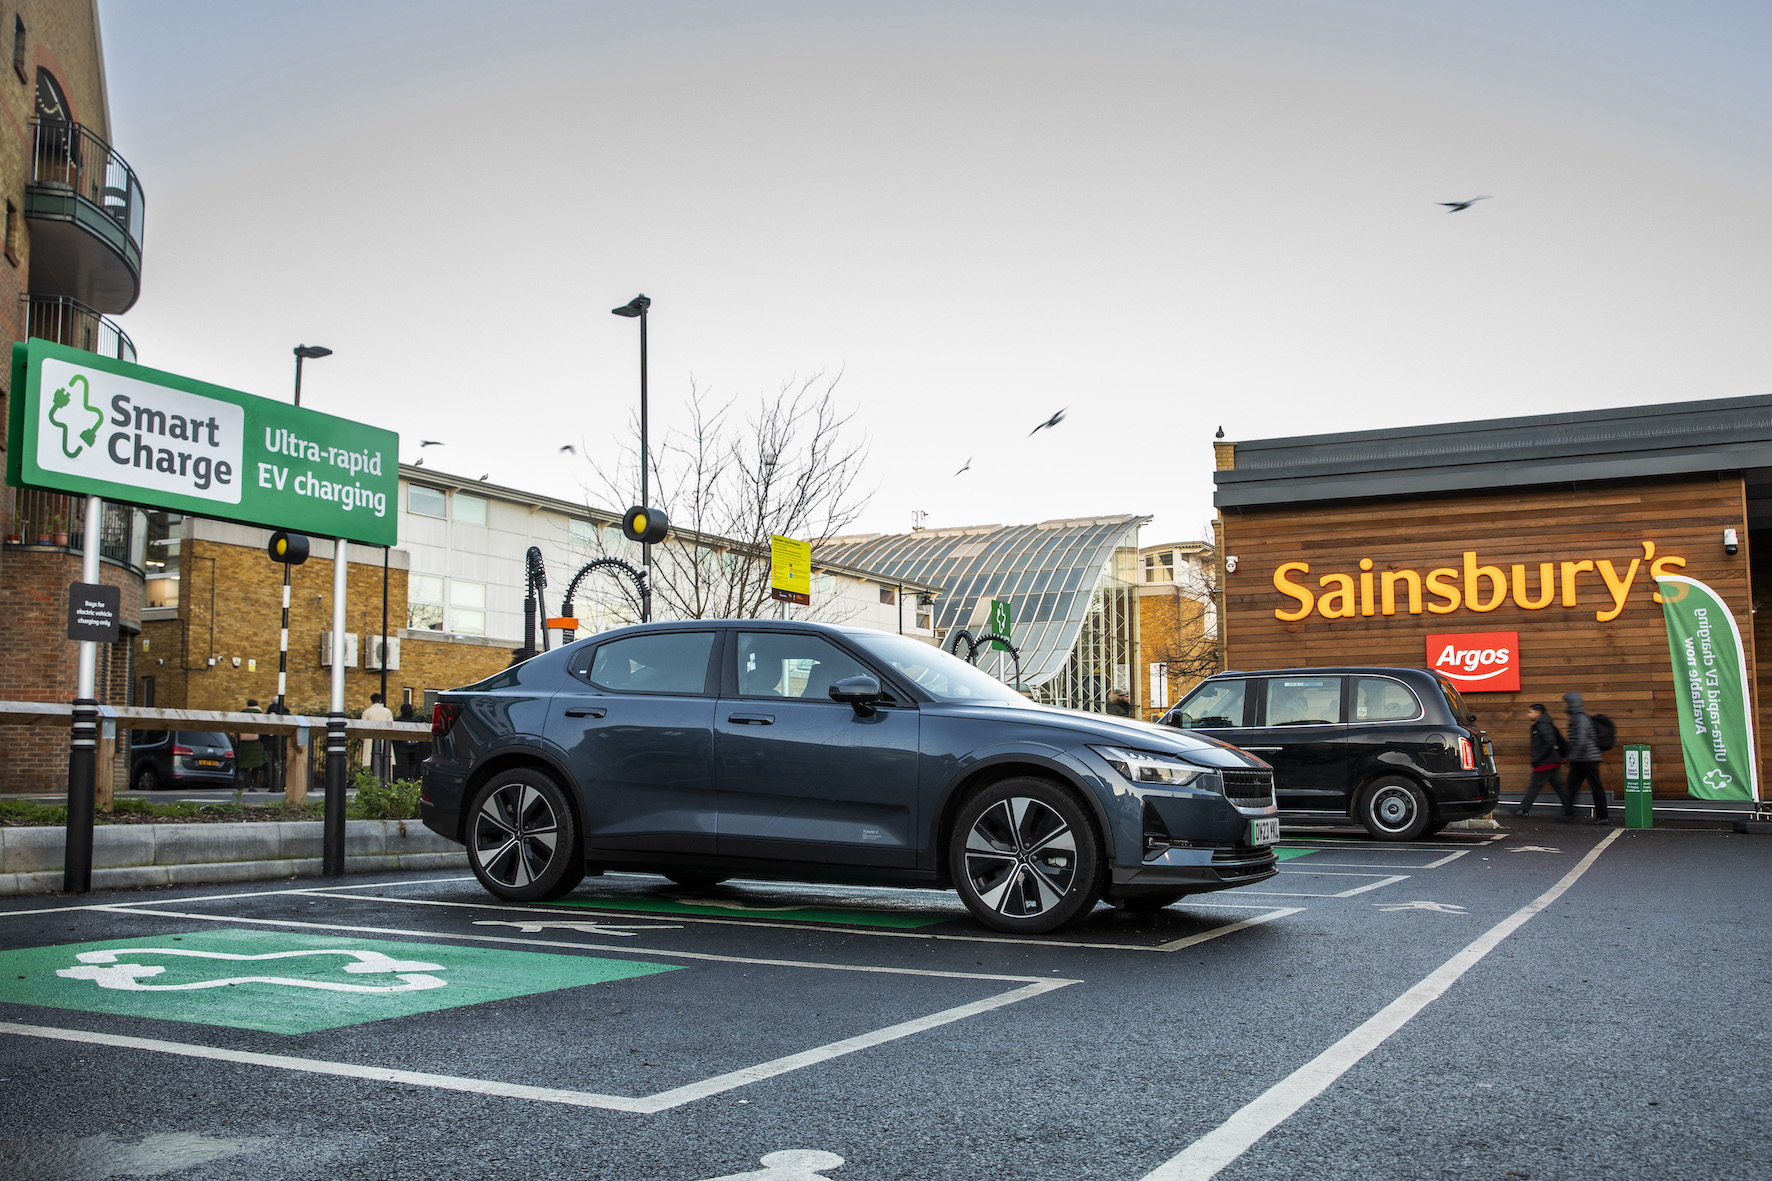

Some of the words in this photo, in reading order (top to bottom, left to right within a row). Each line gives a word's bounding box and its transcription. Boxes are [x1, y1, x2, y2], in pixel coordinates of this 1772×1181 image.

[110, 394, 220, 448] Smart
[107, 431, 232, 490] Charge
[265, 426, 383, 477] Ultra-rapid
[258, 462, 289, 491] EV
[293, 470, 387, 518] charging
[1273, 540, 1690, 622] Sainsbury's
[76, 608, 95, 616] electric
[77, 617, 99, 626] charging
[100, 619, 111, 627] only
[1435, 644, 1510, 672] Argos
